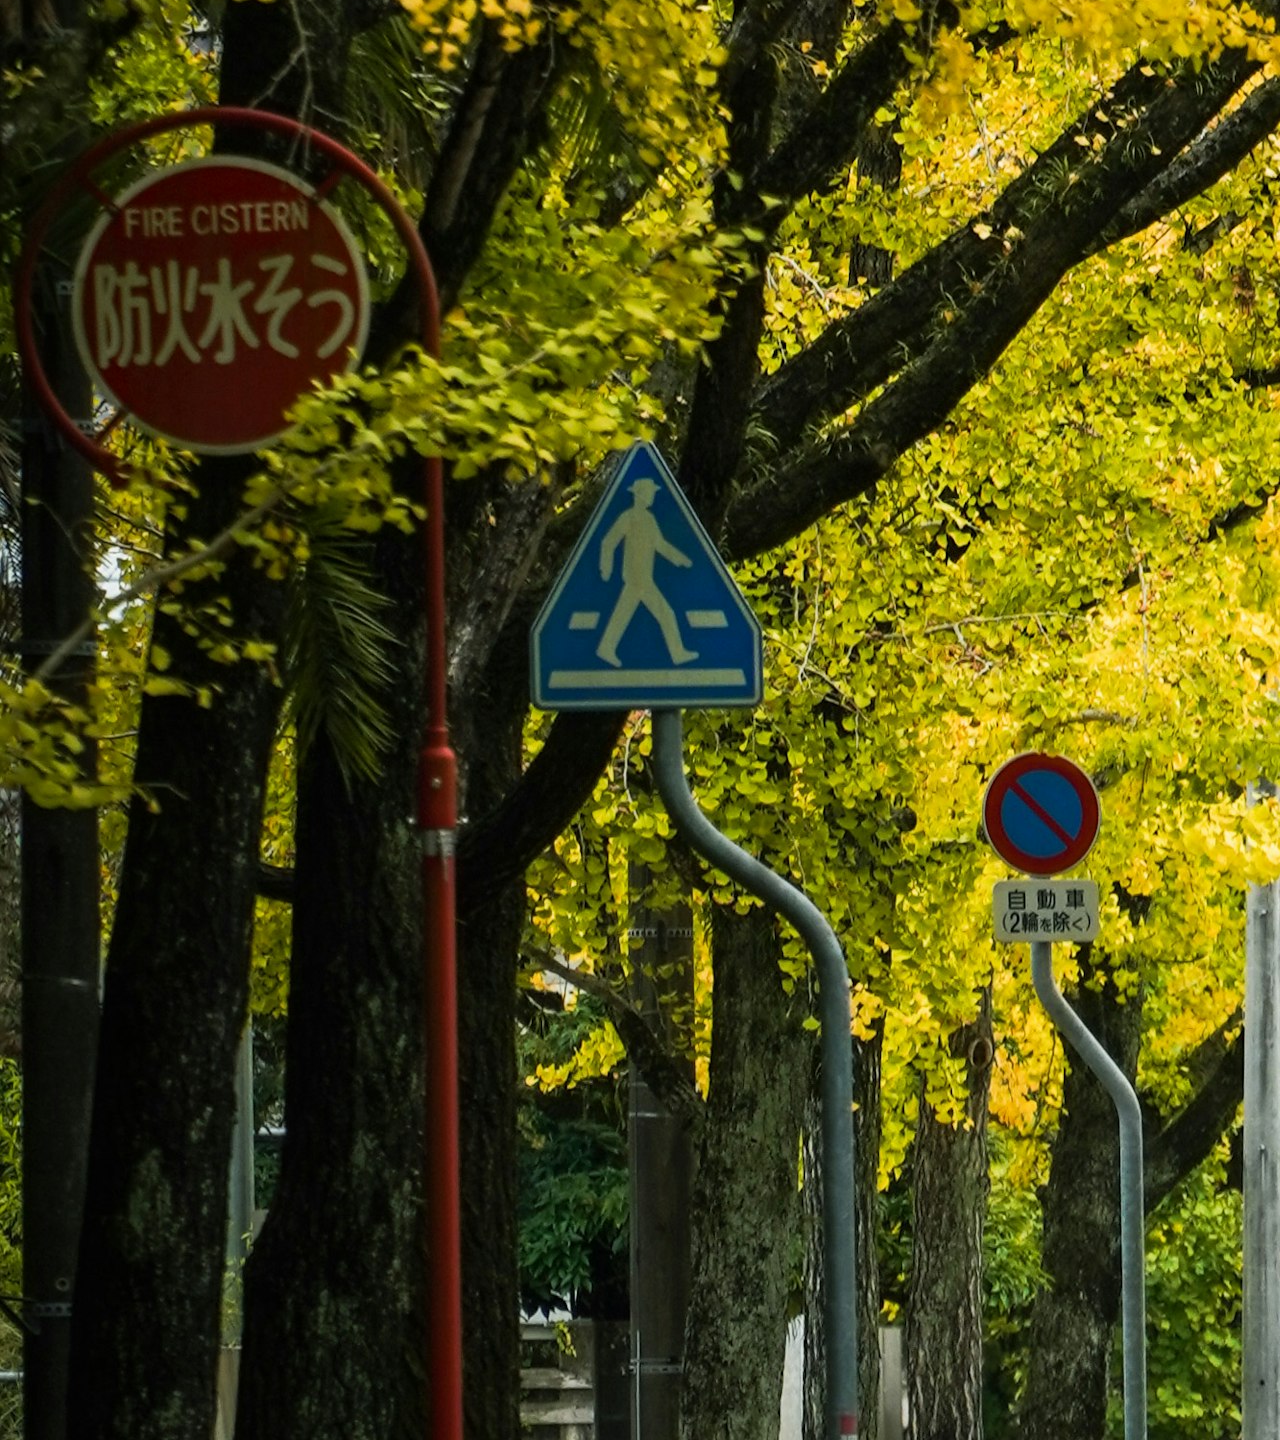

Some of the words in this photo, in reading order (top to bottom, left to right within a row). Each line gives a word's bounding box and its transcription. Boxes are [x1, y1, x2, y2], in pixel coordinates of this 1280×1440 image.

[124, 207, 184, 238] FIRE
[191, 200, 309, 235] CISTERN
[94, 254, 355, 369] 防火水そう
[1008, 888, 1085, 910] 自動車
